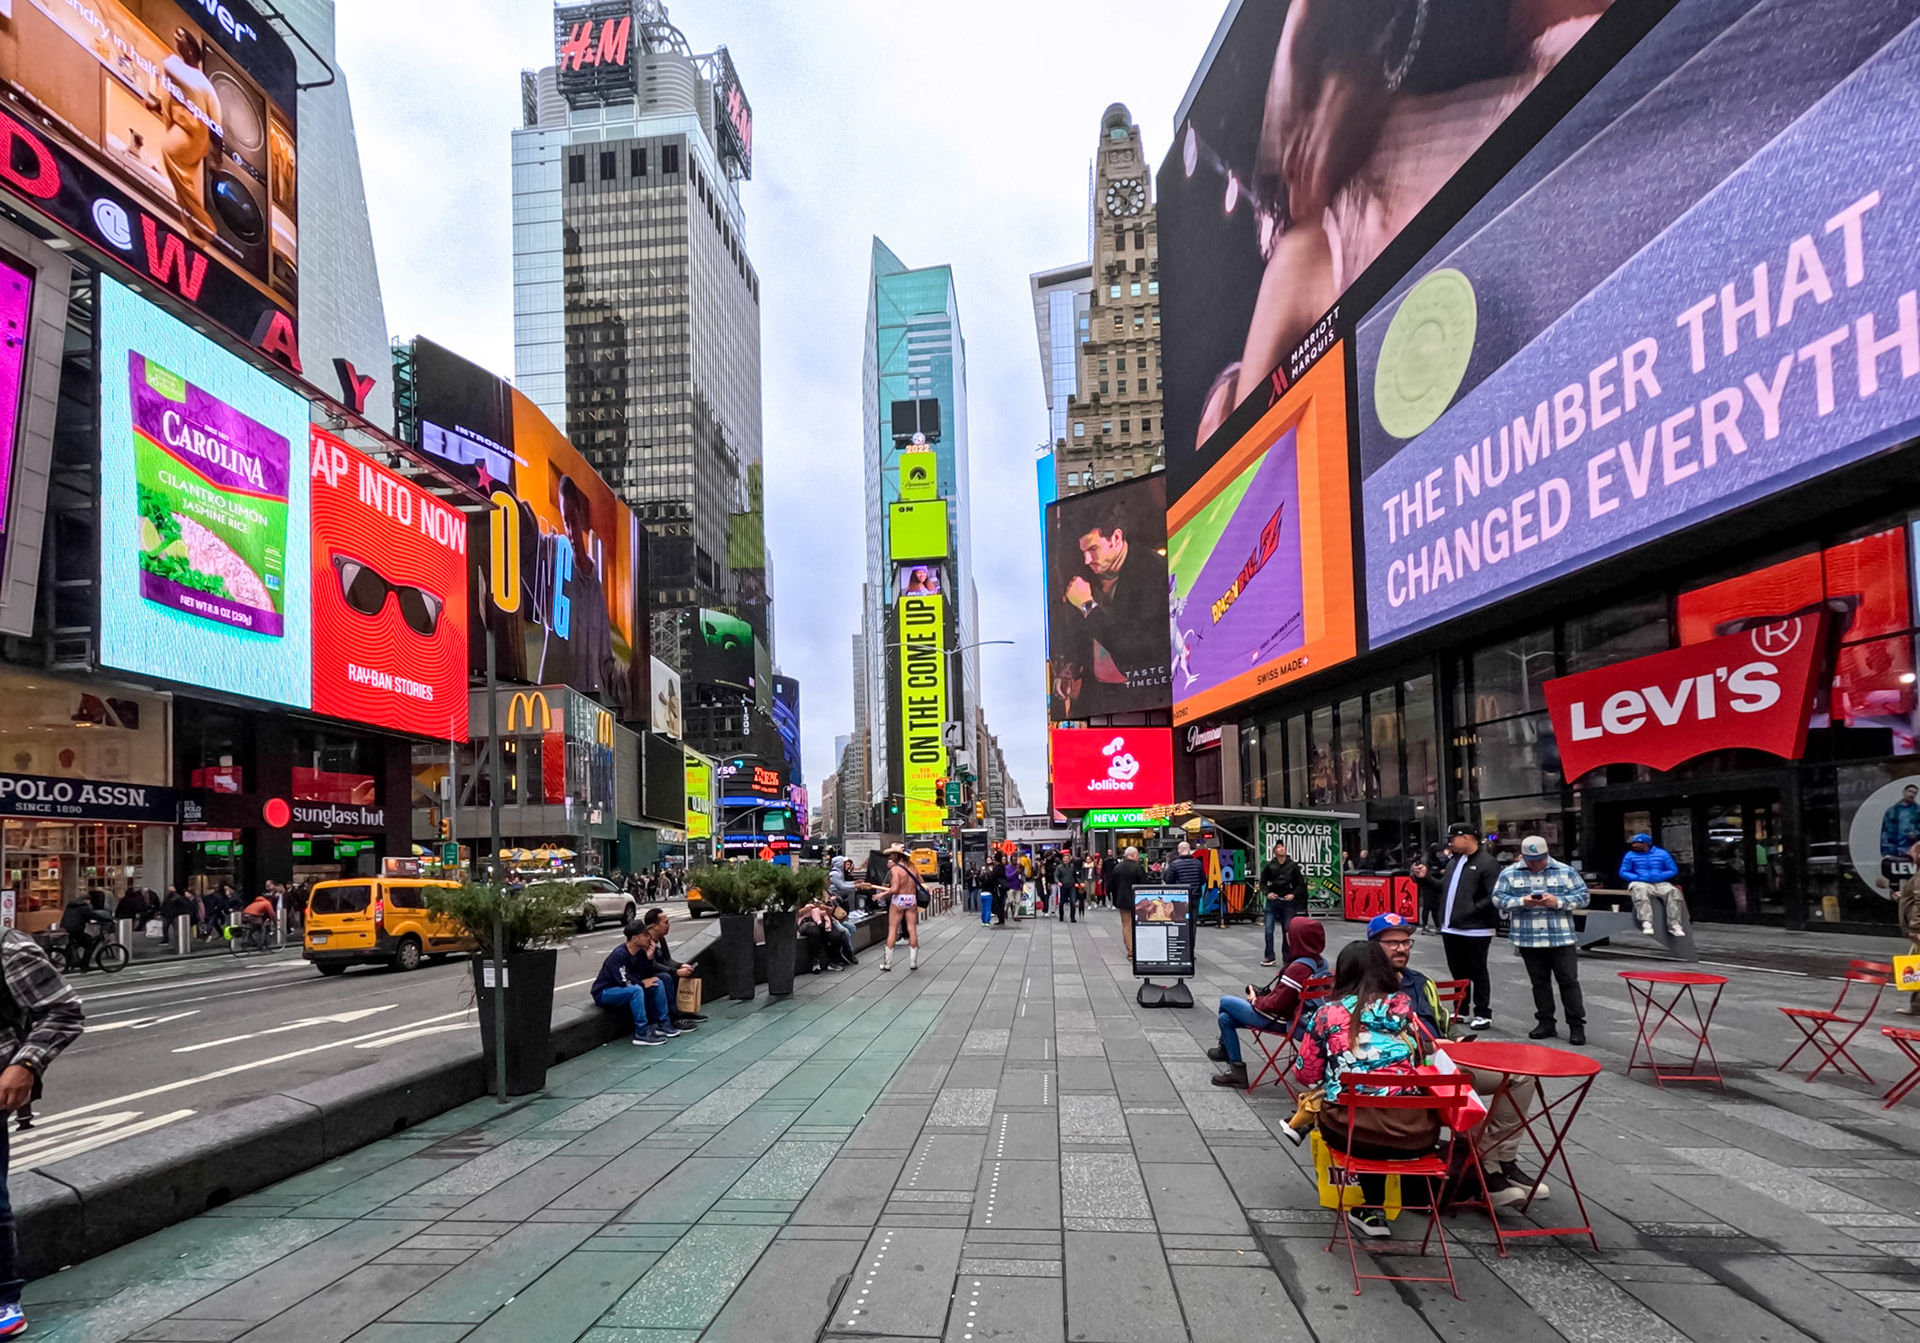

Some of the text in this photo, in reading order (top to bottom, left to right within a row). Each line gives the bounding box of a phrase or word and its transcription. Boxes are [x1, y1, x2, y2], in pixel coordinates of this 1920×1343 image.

[560, 16, 631, 71] H&M
[113, 31, 127, 52] in
[129, 44, 158, 77] half
[162, 75, 184, 101] the
[187, 100, 223, 138] space
[1291, 306, 1340, 364] MARRIOTT
[1291, 329, 1335, 379] MARQUIS
[1383, 190, 1881, 544] THE NUMBER THAT
[163, 410, 268, 491] CAROLINA
[454, 424, 529, 468] INTRODUCING
[906, 444, 930, 454] 2022
[1387, 289, 1920, 608] CHANGED EVERYTH
[159, 470, 226, 508] CILANTRO
[228, 501, 268, 527] LIMON
[309, 432, 468, 555] AP INTO NOW
[183, 498, 226, 525] JASMINE
[228, 518, 249, 534] RICE
[180, 594, 195, 607] NET
[196, 598, 207, 611] WT
[221, 607, 232, 619] OZ
[905, 599, 936, 625] UP
[907, 631, 938, 689] COME
[1125, 666, 1165, 679] TASTE
[1257, 657, 1302, 686] SWISS MADE
[394, 677, 434, 701] STORIES
[908, 694, 939, 732] THE
[909, 735, 940, 764] ON
[0, 778, 150, 808] POLO ASSN.
[1087, 779, 1134, 791] Jollibee
[15, 802, 83, 814] SINCE 1890
[293, 804, 385, 829] sunglass hut
[1093, 814, 1119, 823] NEW
[1266, 823, 1332, 836] DISCOVER
[1266, 833, 1333, 864] BADWAY'S
[1297, 864, 1333, 877] RETS
